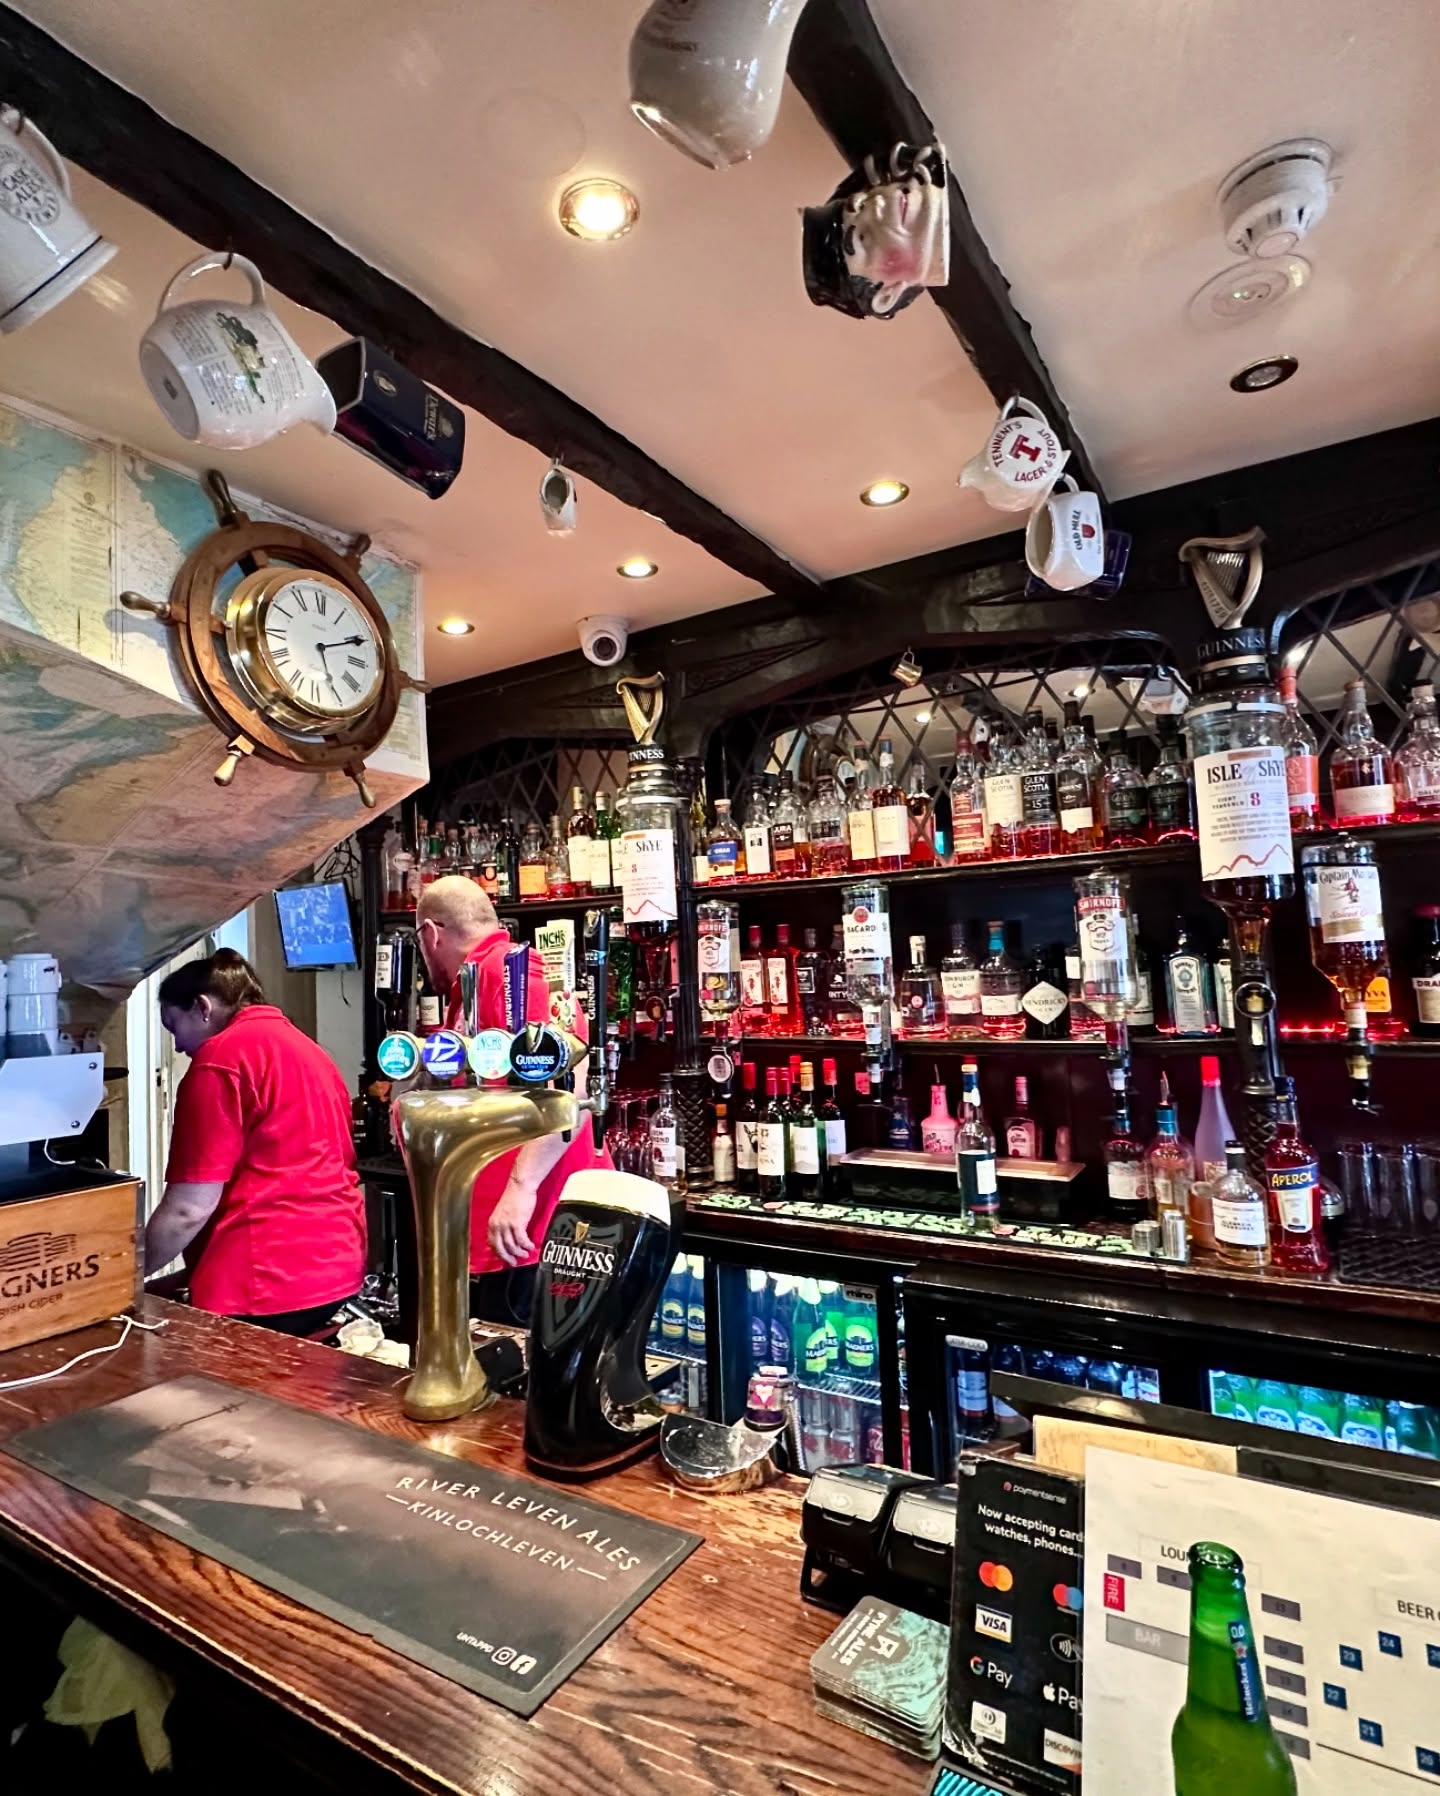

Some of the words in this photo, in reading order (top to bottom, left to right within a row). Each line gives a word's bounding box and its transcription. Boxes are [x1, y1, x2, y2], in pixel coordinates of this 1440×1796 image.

[991, 421, 1023, 468] TENNENT'S
[1014, 467, 1047, 482] LAGER
[1037, 428, 1057, 460] STOUT
[1197, 636, 1265, 657] GUINNES
[629, 749, 665, 761] INNESS
[1025, 776, 1046, 785] GLEN
[1207, 763, 1242, 784] ISLE
[1250, 792, 1261, 807] 8
[1320, 869, 1350, 884] Captain
[847, 925, 877, 933] BACARD
[587, 975, 597, 1021] GUINNESS
[516, 1055, 555, 1065] GUINNESS
[1271, 1171, 1315, 1187] APEROL
[542, 1240, 615, 1275] GUINNESS
[1, 1254, 100, 1298] GNERS
[554, 1268, 587, 1279] DRAUGHT
[396, 1477, 481, 1498] RIVER
[491, 1491, 578, 1531] LEVEN
[576, 1529, 641, 1572] ALES
[978, 1504, 1003, 1520] Now
[1004, 1513, 1056, 1538] accepting
[1059, 1526, 1085, 1543] card
[985, 1523, 1032, 1545] watches,
[1161, 1545, 1189, 1562] LOU
[1107, 1576, 1119, 1605] FIRE
[1397, 1599, 1436, 1621] BEER
[982, 1614, 1007, 1633] VISA
[1135, 1627, 1161, 1647] BAR
[1381, 1636, 1395, 1648] 24
[840, 1637, 866, 1666] ALES
[1343, 1650, 1356, 1662] 23
[987, 1661, 1013, 1689] Pay
[1327, 1688, 1340, 1701] 22
[1361, 1724, 1375, 1737] 21
